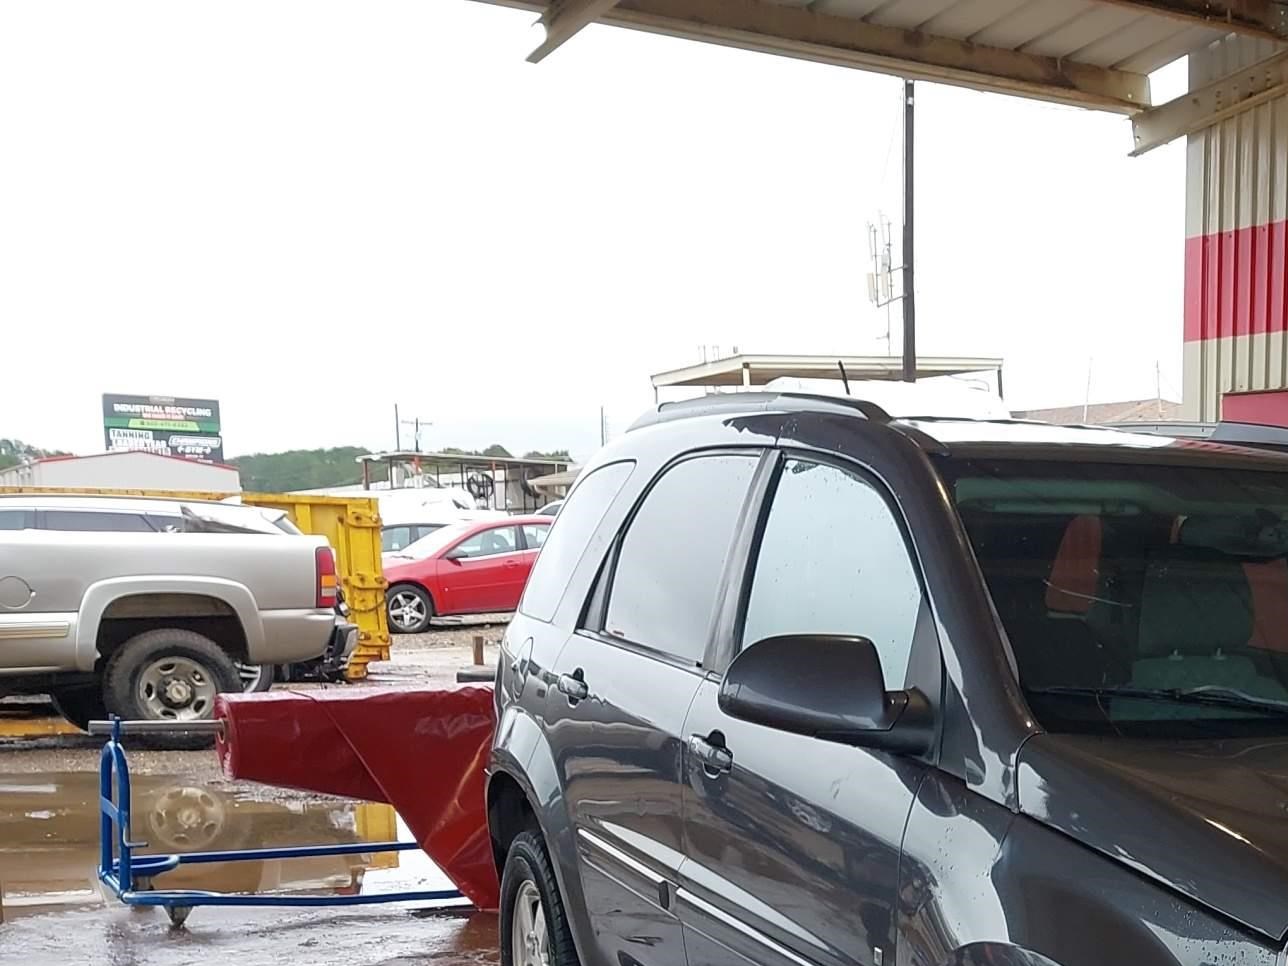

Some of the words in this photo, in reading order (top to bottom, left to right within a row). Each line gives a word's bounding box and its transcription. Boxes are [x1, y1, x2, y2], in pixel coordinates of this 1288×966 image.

[113, 404, 164, 414] INDUSTRIAL
[164, 406, 212, 417] RECYCLING
[111, 429, 151, 440] TANNING
